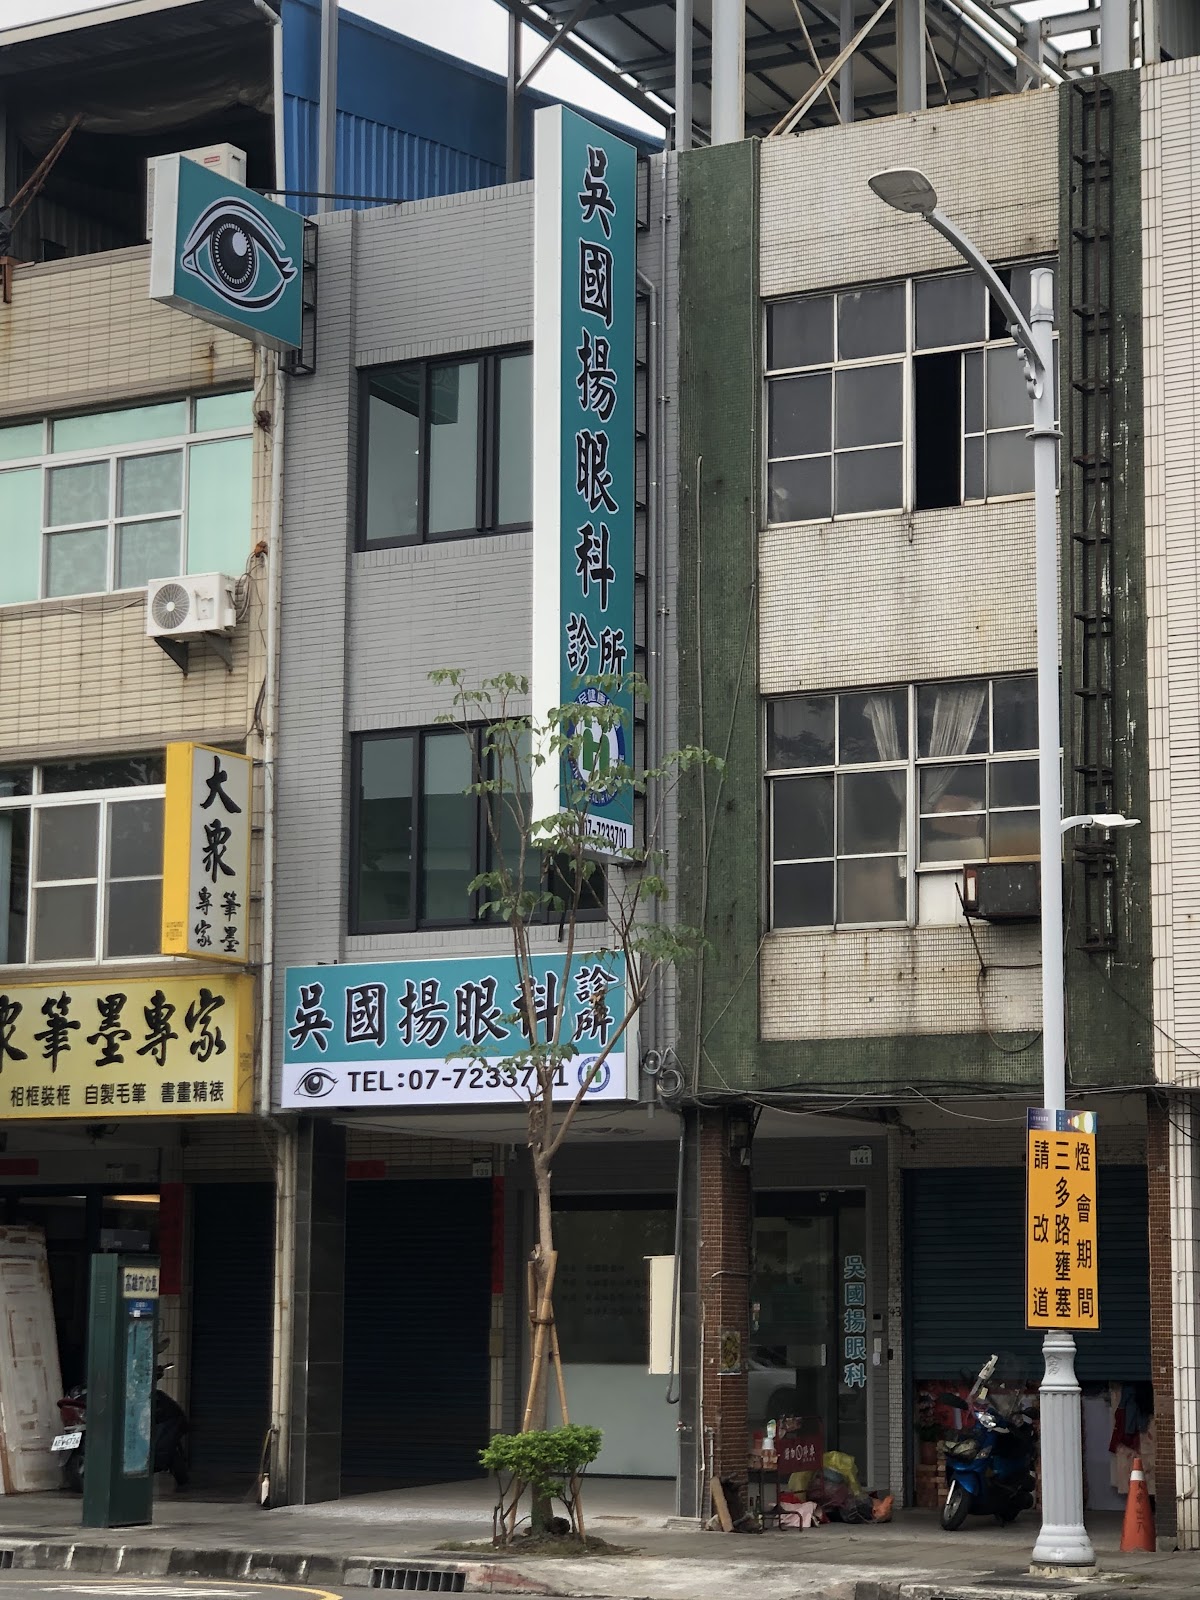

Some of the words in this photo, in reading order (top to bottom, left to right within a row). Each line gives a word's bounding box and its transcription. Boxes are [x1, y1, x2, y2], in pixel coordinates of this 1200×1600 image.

[575, 143, 617, 612] 吳國揚眼科
[565, 612, 628, 692] 診所
[193, 885, 213, 948] 專家
[219, 890, 242, 953] 筆墨
[288, 970, 566, 1053] 吳國揚眼科
[10, 1084, 71, 1108] 相框裝框
[85, 1082, 147, 1106] 自製毛筆
[160, 1080, 224, 1104] 書畫精裱
[347, 1064, 569, 1093] TEL:07-723371
[1032, 1139, 1050, 1318] 請改道
[1054, 1141, 1072, 1318] 三多路壅塞
[1074, 1141, 1094, 1319] 燈會期間
[844, 1255, 866, 1388] 吳國揚眼科
